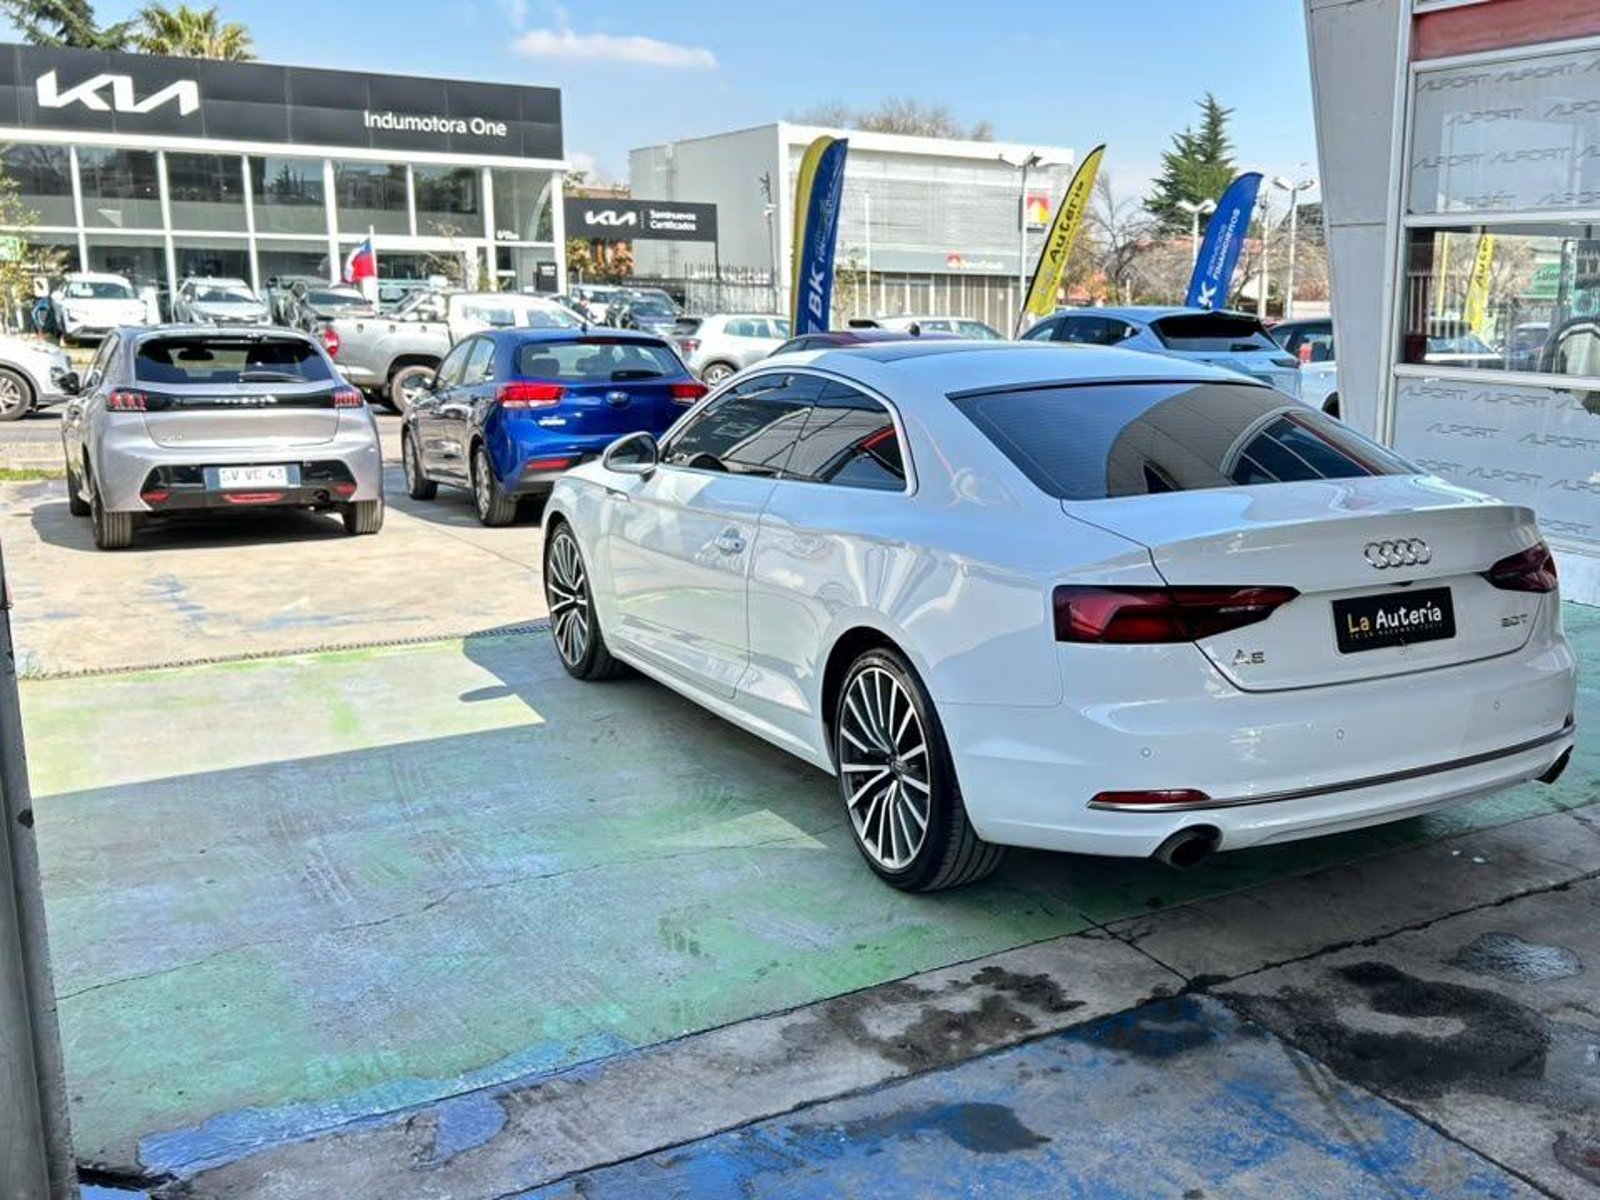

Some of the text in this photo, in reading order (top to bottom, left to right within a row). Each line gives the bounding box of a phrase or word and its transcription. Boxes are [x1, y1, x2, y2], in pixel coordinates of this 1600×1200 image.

[363, 109, 508, 137] Indumotora One
[1212, 208, 1241, 281] FINANCIEROS
[1426, 422, 1501, 439] ALPORT
[1347, 612, 1370, 634] La
[1375, 601, 1443, 630] Autería
